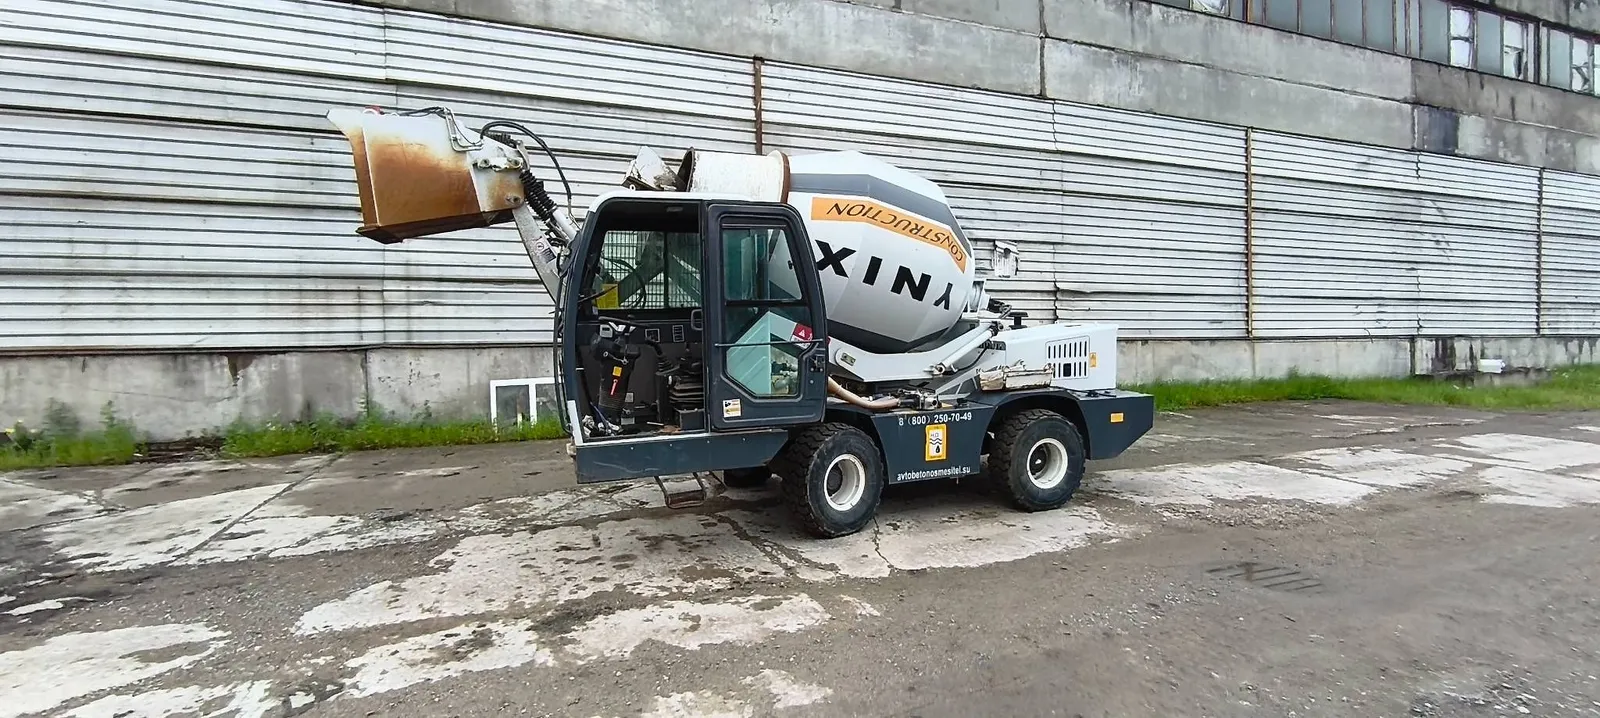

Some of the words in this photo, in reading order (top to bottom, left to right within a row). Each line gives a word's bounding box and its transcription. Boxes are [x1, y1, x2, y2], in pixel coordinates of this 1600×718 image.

[826, 202, 964, 262] CONSTRUCTION
[899, 418, 904, 426] 8
[933, 412, 972, 424] 250-70-49
[896, 466, 971, 481] avtobetonosmesitel.su
